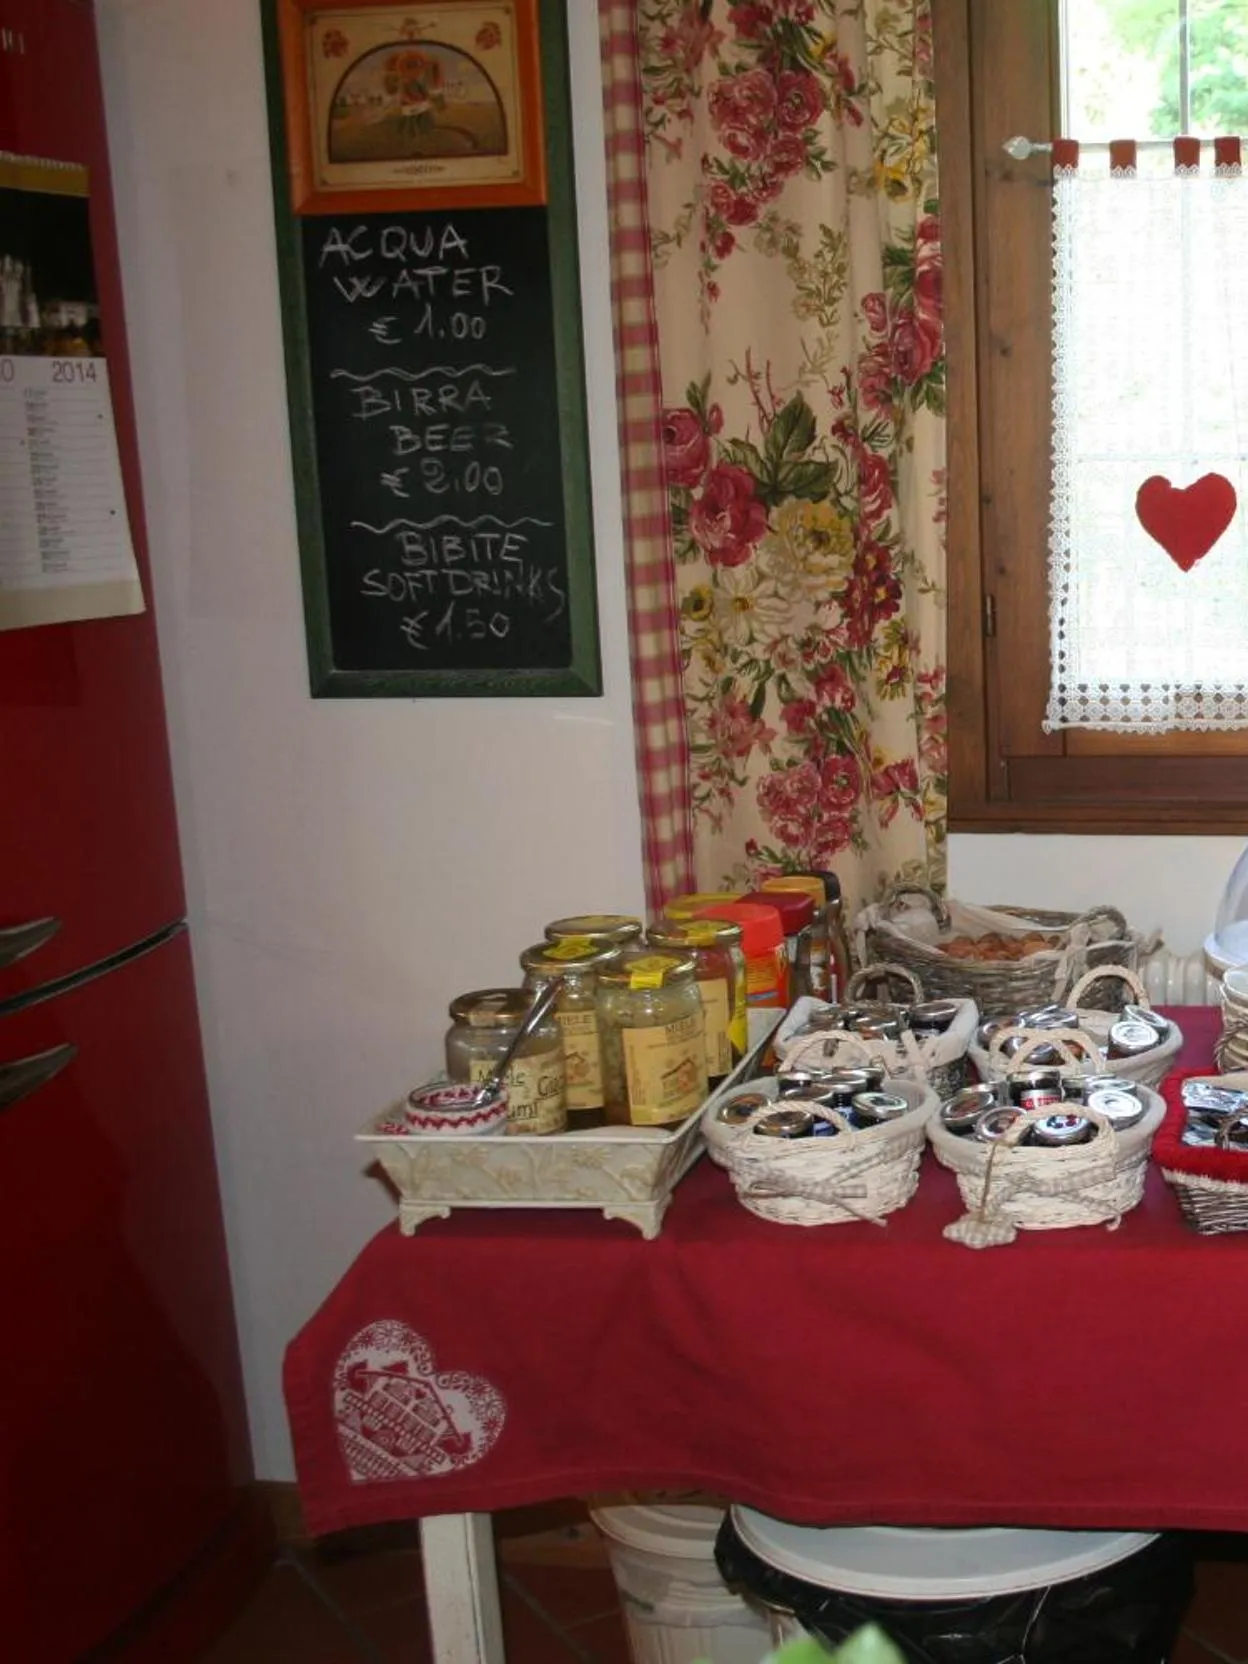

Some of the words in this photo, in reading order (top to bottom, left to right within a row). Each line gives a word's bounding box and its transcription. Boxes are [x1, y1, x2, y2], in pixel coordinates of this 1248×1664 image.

[318, 223, 470, 269] ACQUA
[332, 265, 515, 307] WATER
[413, 302, 487, 340] 1.00
[52, 360, 98, 383] 2014
[351, 380, 493, 420] BIRRA
[388, 423, 514, 456] BEER
[395, 531, 529, 568] BIBITE
